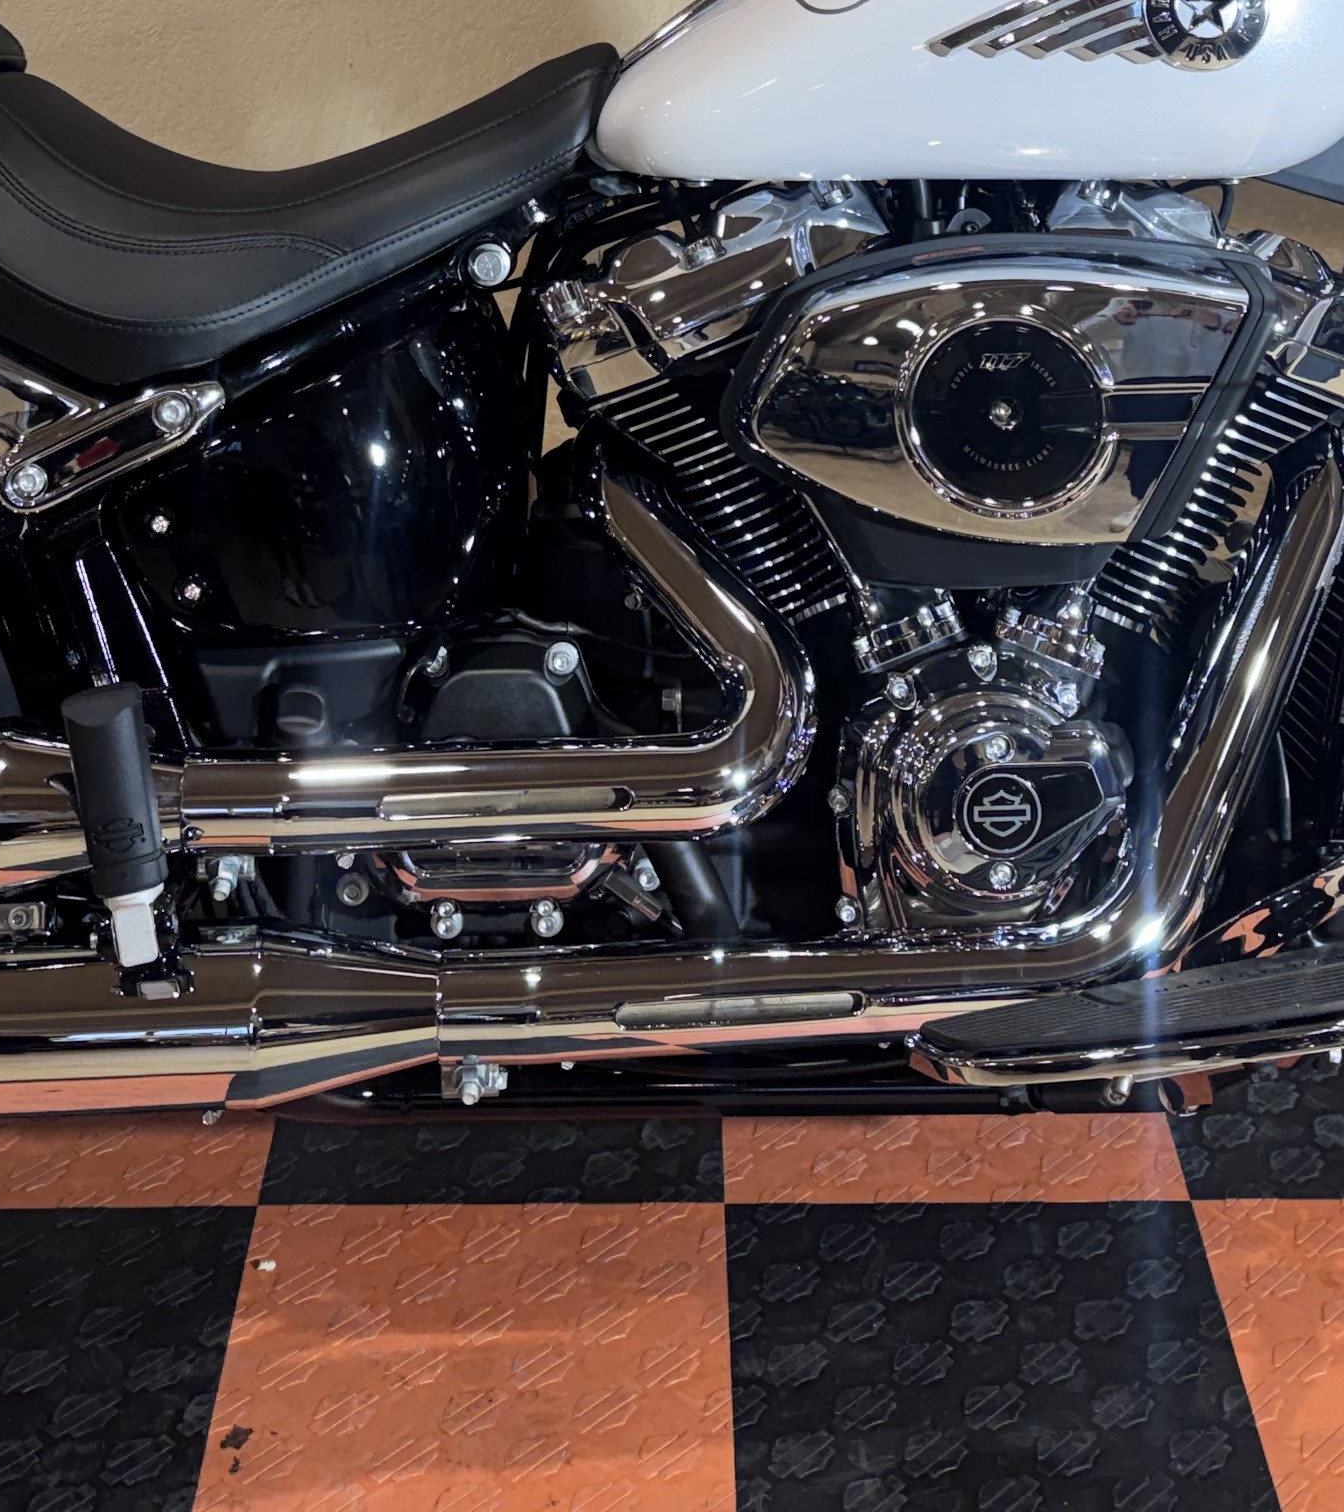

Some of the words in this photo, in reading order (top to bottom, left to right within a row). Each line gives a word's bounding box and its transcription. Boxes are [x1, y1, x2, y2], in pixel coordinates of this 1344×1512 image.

[1184, 41, 1231, 64] USA
[950, 362, 974, 389] CUBIC
[979, 352, 1033, 371] 117
[1029, 360, 1057, 387] INCHES
